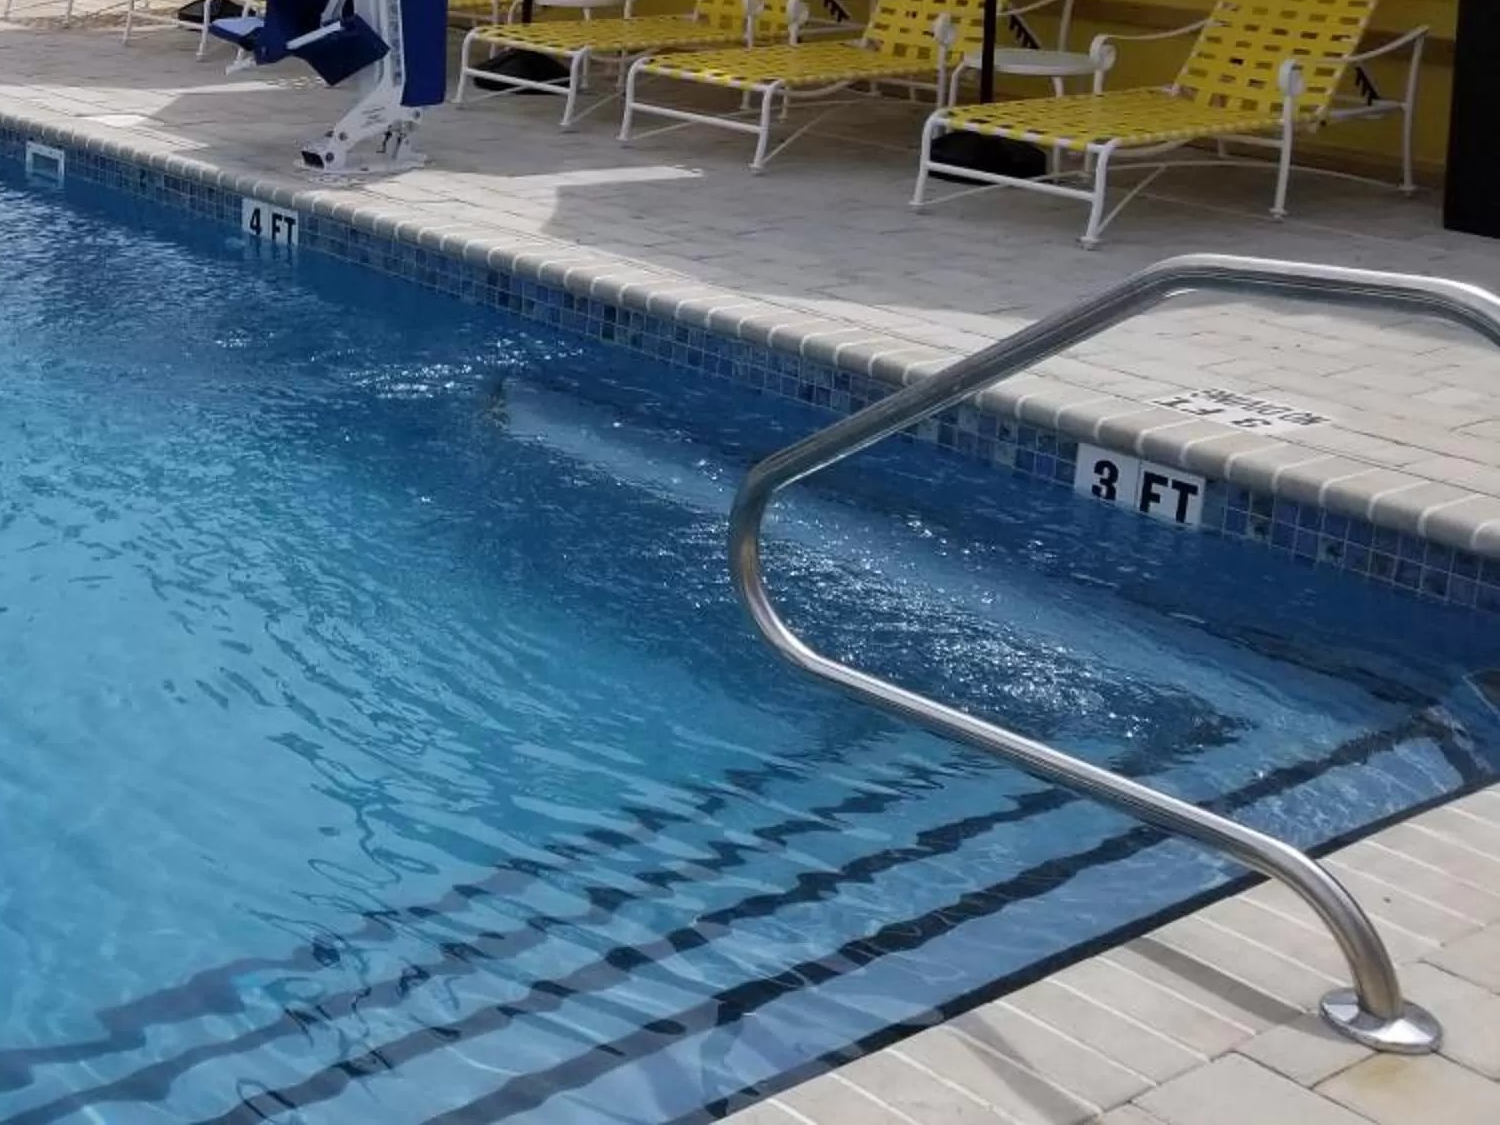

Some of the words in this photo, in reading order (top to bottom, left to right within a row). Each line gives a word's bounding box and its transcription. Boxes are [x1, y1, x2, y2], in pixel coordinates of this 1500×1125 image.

[250, 208, 262, 236] 4
[272, 212, 296, 245] FT
[1092, 460, 1119, 501] 3
[1140, 470, 1199, 524] FT
